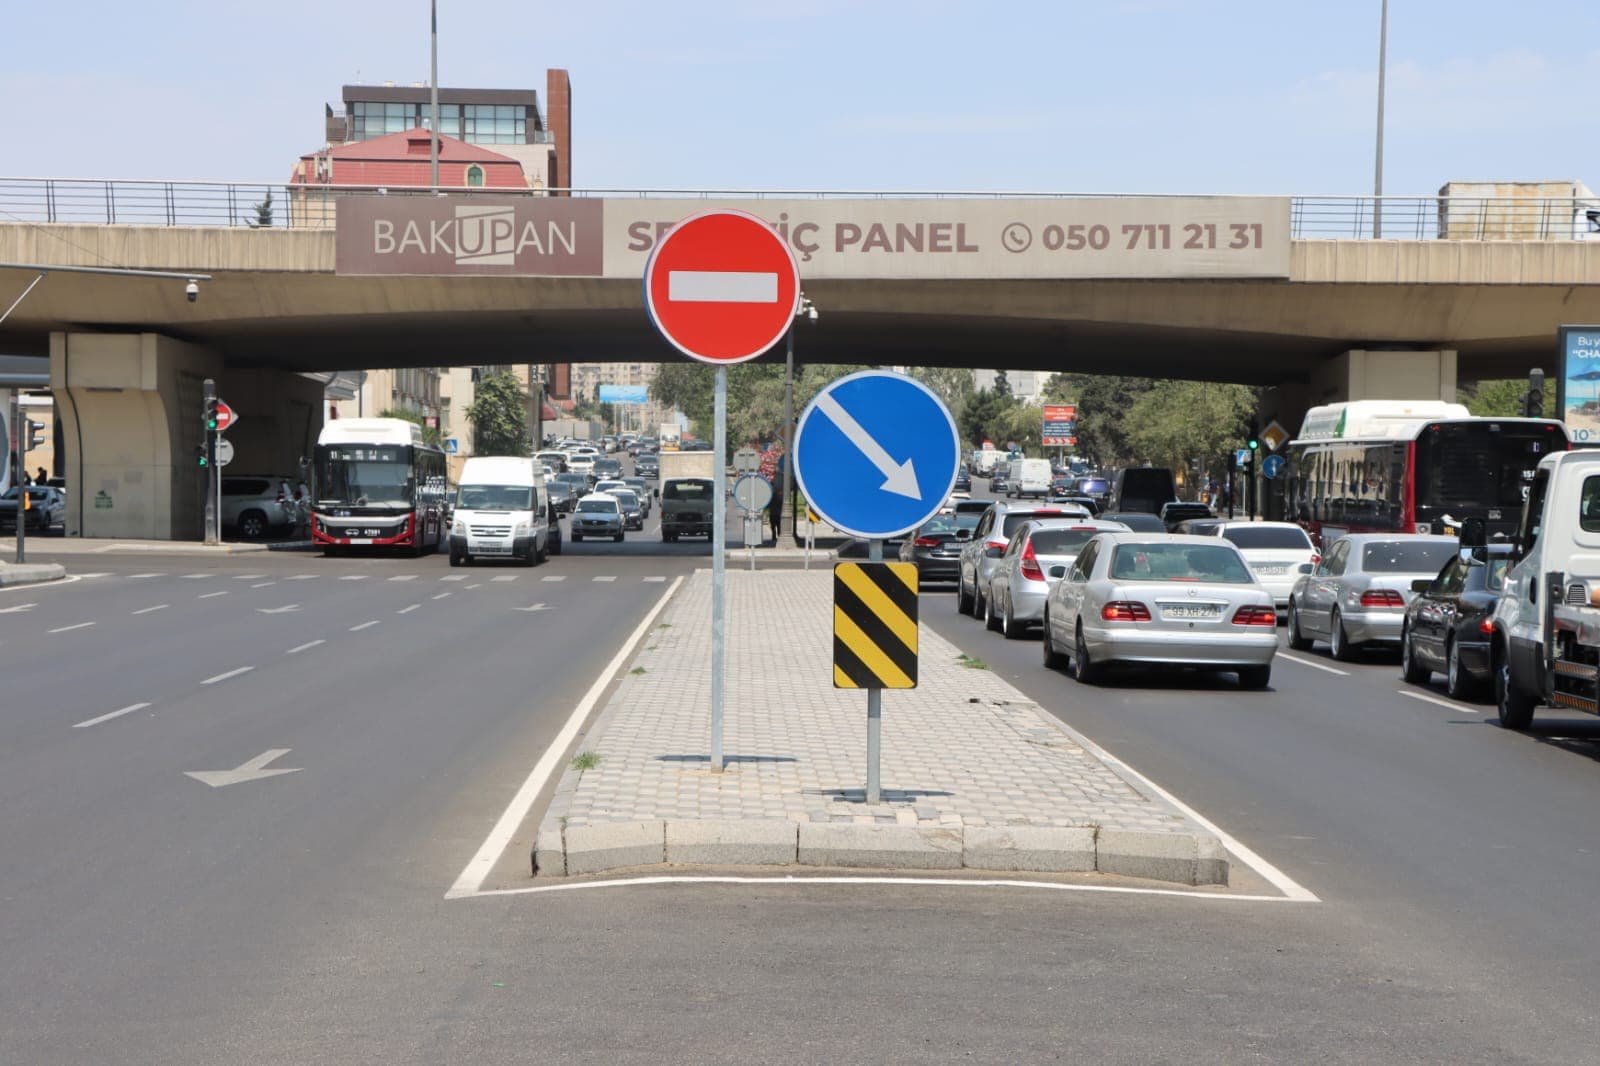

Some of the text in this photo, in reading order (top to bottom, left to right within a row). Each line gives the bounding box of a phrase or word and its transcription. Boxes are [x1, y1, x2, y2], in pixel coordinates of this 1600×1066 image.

[373, 218, 576, 256] BAKUPAN
[834, 222, 980, 253] PANEL
[1042, 222, 1263, 251] 050 711 21 31
